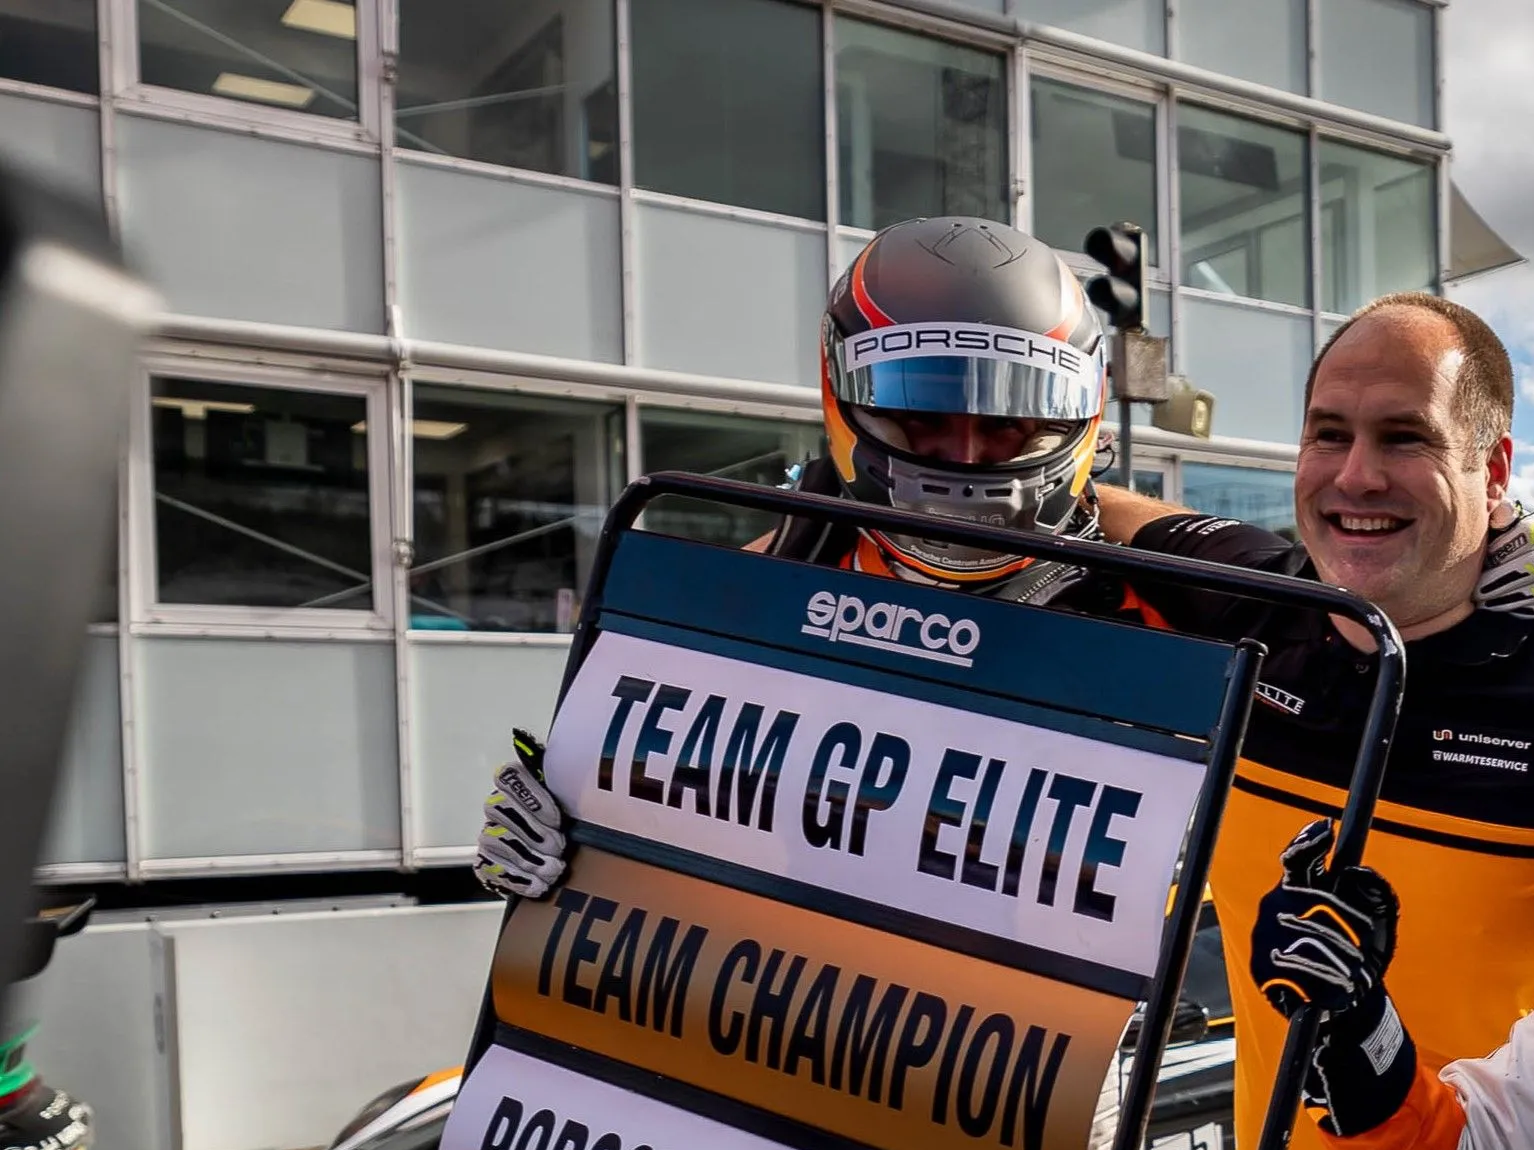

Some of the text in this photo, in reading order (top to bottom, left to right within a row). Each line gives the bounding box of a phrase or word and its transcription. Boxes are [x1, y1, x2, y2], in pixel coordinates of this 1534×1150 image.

[853, 329, 1081, 374] PORSCHE
[803, 590, 981, 658] sparco
[1443, 751, 1529, 772] WARMTESERVICE
[1458, 731, 1532, 750] uniserver
[597, 675, 1144, 923] TEAM GP ELITE
[536, 888, 709, 1040] TEAM
